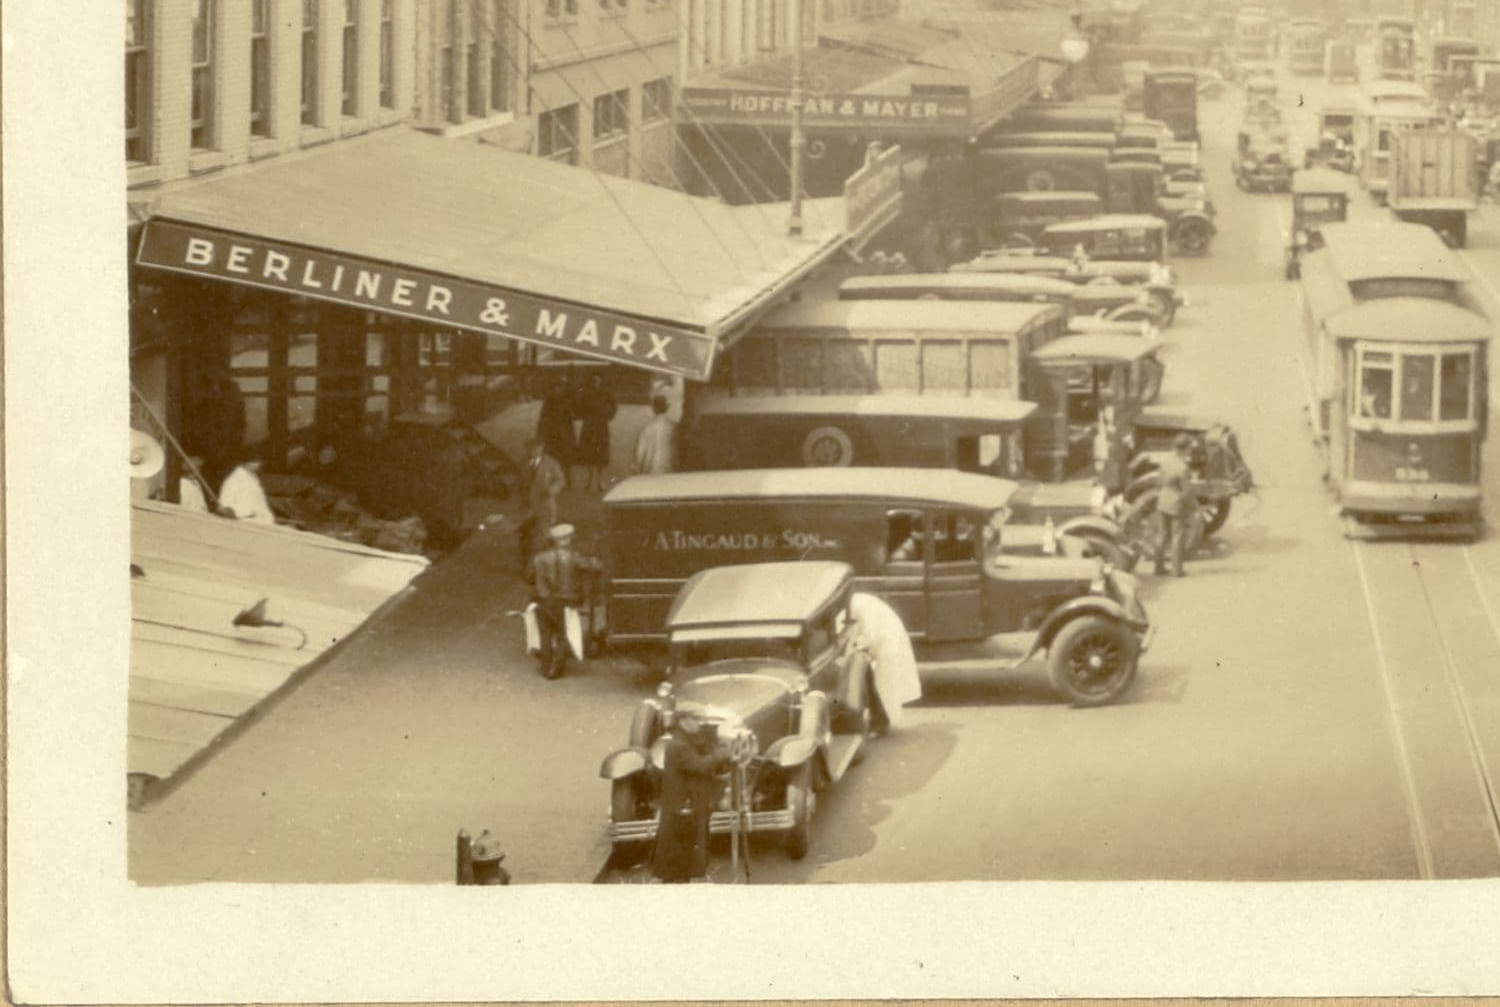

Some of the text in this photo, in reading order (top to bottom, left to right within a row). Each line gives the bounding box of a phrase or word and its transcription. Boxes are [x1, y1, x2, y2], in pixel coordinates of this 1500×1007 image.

[837, 98, 856, 115] &
[862, 100, 939, 117] MAYER
[184, 236, 674, 363] BERLINER & MARX
[782, 528, 821, 549] SON
